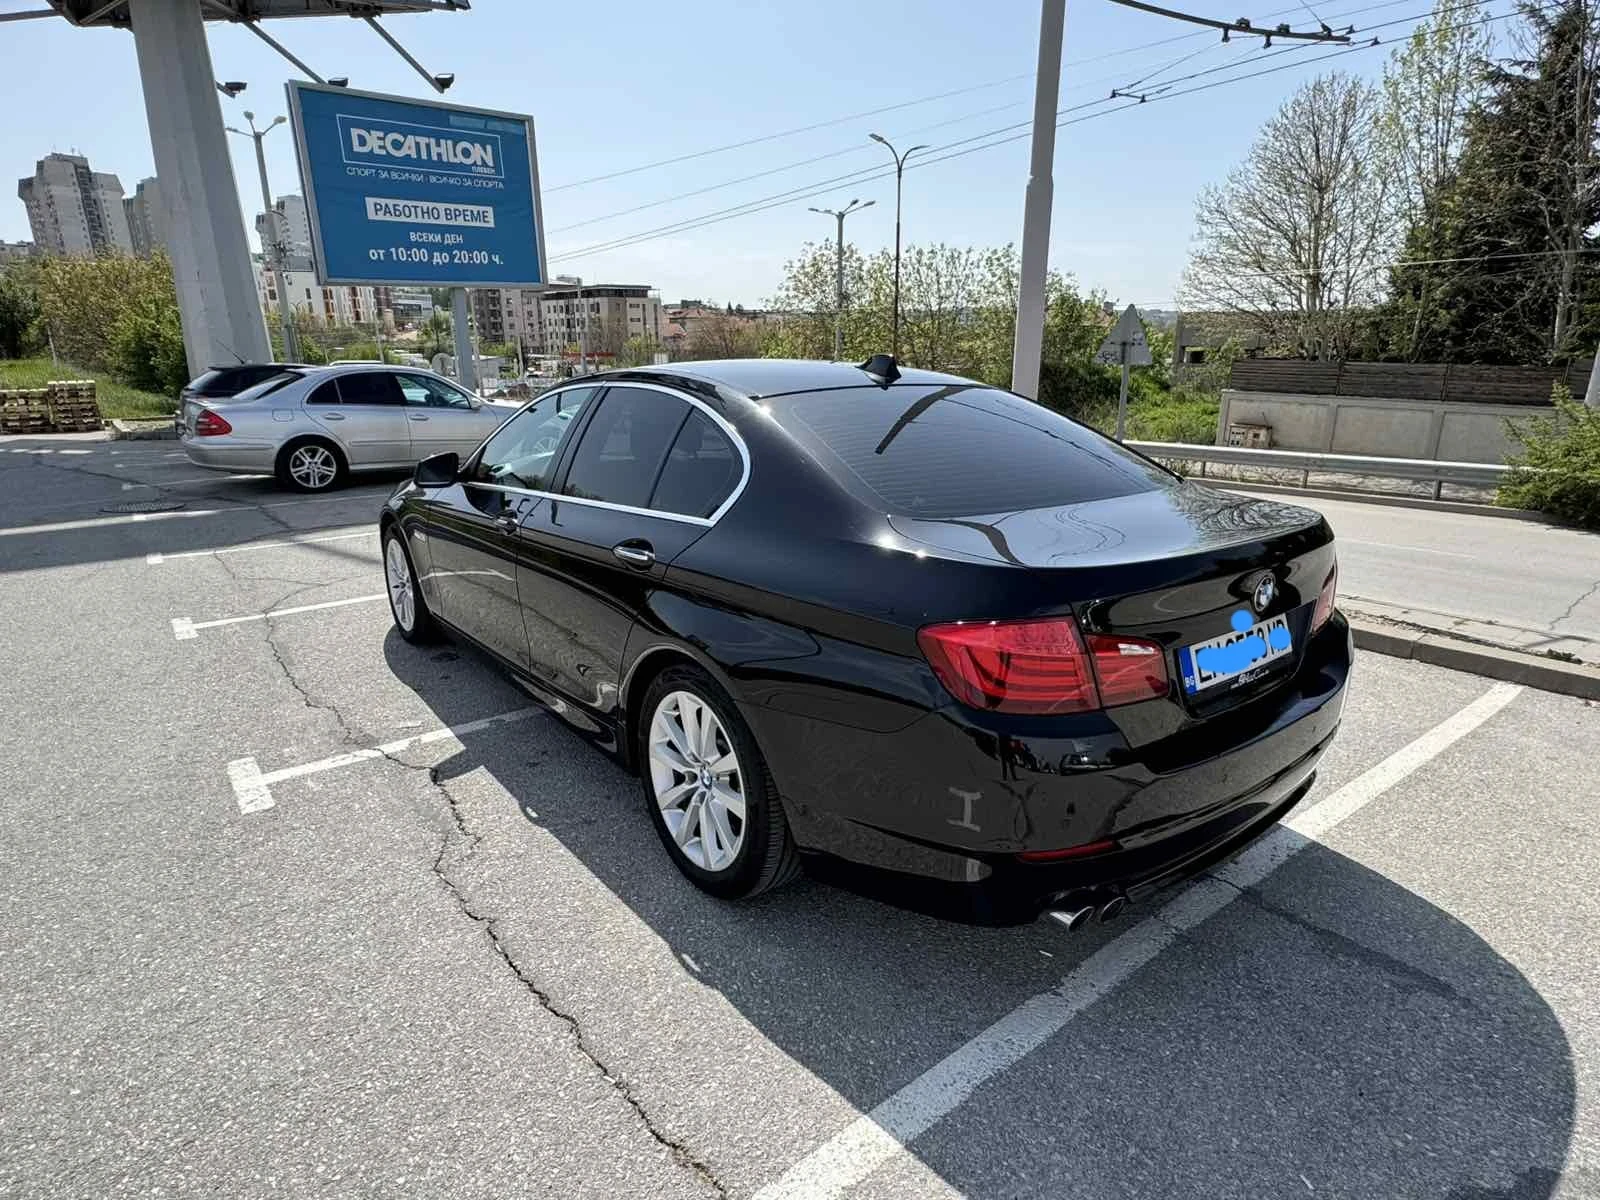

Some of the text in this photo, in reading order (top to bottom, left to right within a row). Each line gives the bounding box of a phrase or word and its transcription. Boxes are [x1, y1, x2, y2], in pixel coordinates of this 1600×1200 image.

[350, 127, 495, 167] DECATHLON
[346, 166, 504, 190] СПОРТ ЗА ВСИЧКИ ВСИЧКО ЗА СПОРТА
[374, 202, 490, 224] РАБОТНО ВРЕМЕ
[409, 231, 464, 245] ВСЕКИ ДЕН
[369, 247, 504, 265] от 10:00 до 20:00 ч.
[1184, 675, 1195, 688] BG
